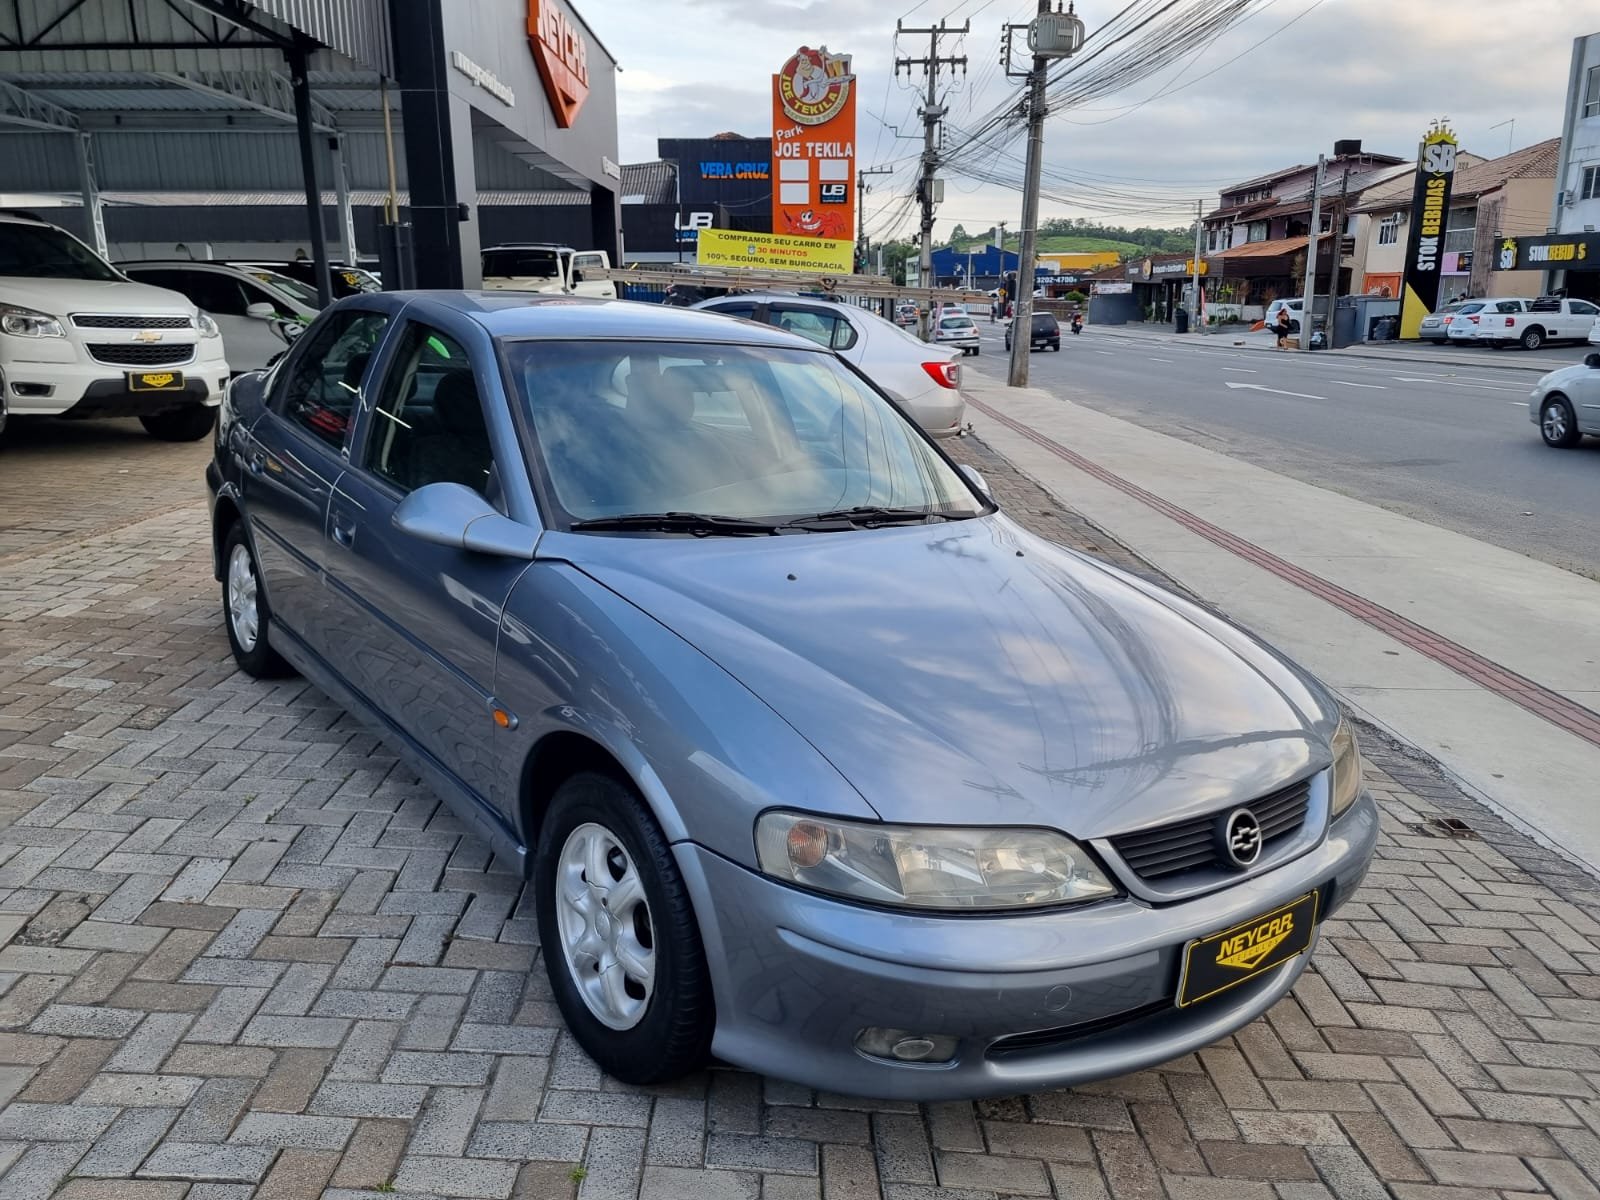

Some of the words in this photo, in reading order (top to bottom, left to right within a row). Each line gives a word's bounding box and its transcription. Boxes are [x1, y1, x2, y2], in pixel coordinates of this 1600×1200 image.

[537, 0, 588, 88] NEYCAR
[783, 74, 794, 100] JOE
[794, 92, 838, 115] TEKILA
[776, 125, 804, 141] Park
[775, 142, 800, 158] JOE
[806, 142, 853, 158] TEKILA
[1424, 144, 1456, 173] SB
[700, 162, 732, 179] VERA
[735, 162, 769, 179] CRUZ
[821, 184, 846, 196] UB
[674, 212, 714, 231] UB
[718, 233, 772, 244] COMPRAMOS
[774, 238, 791, 246] SEU
[793, 240, 822, 248] CARRO
[706, 252, 728, 261] 100%
[730, 254, 767, 264] SEGURO,
[769, 257, 787, 266] SEM
[757, 246, 768, 254] 30
[769, 248, 808, 257] MINUTOS
[1216, 913, 1294, 961] NEYCAR
